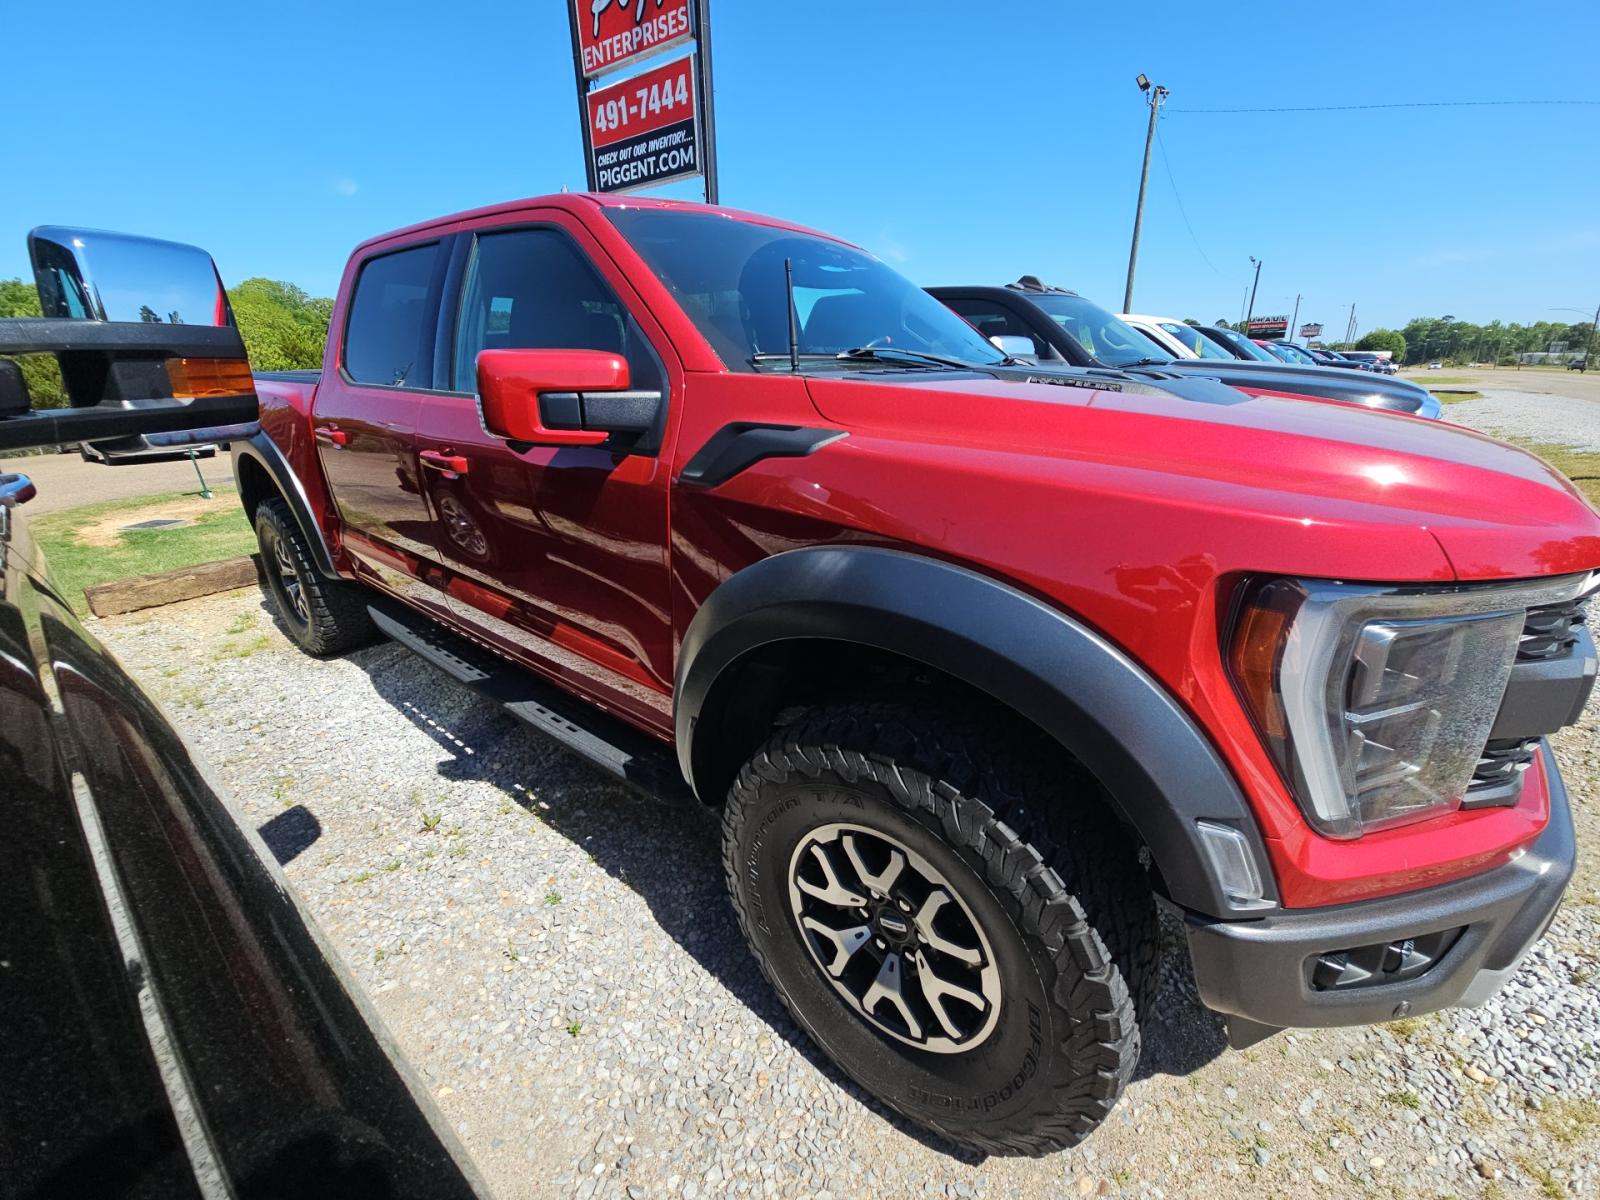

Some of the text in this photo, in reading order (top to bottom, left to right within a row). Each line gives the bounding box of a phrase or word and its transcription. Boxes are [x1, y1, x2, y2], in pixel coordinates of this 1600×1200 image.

[583, 6, 688, 69] ENTERPRISES
[595, 74, 688, 132] 491-7444
[598, 151, 618, 167] CHECK
[619, 148, 632, 160] OUT
[633, 143, 647, 155] OUR
[599, 145, 694, 188] PIGGENT.COM
